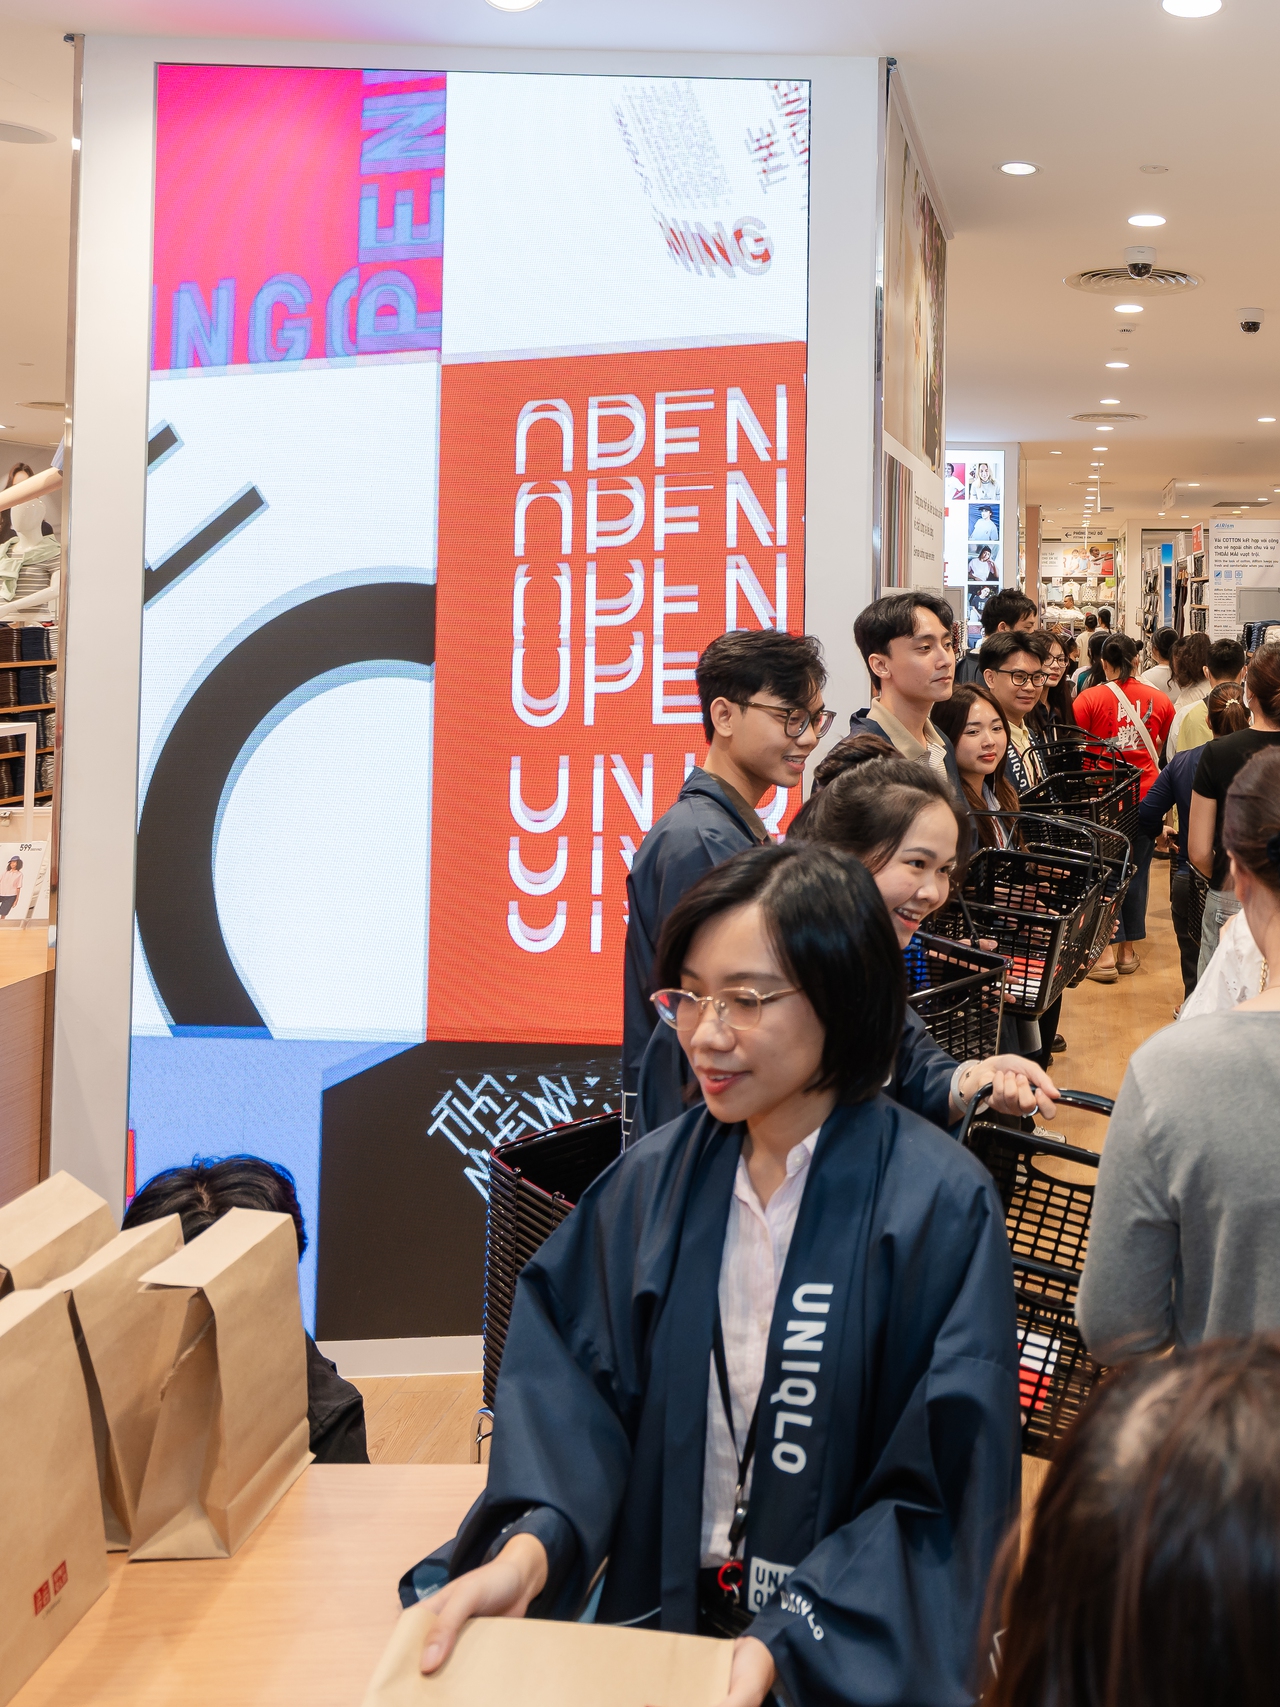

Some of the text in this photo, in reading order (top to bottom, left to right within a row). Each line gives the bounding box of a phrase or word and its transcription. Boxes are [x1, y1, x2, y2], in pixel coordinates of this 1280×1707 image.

[1007, 744, 1027, 788] NIQLO
[20, 843, 32, 851] 599
[770, 1283, 834, 1475] UNIQLO
